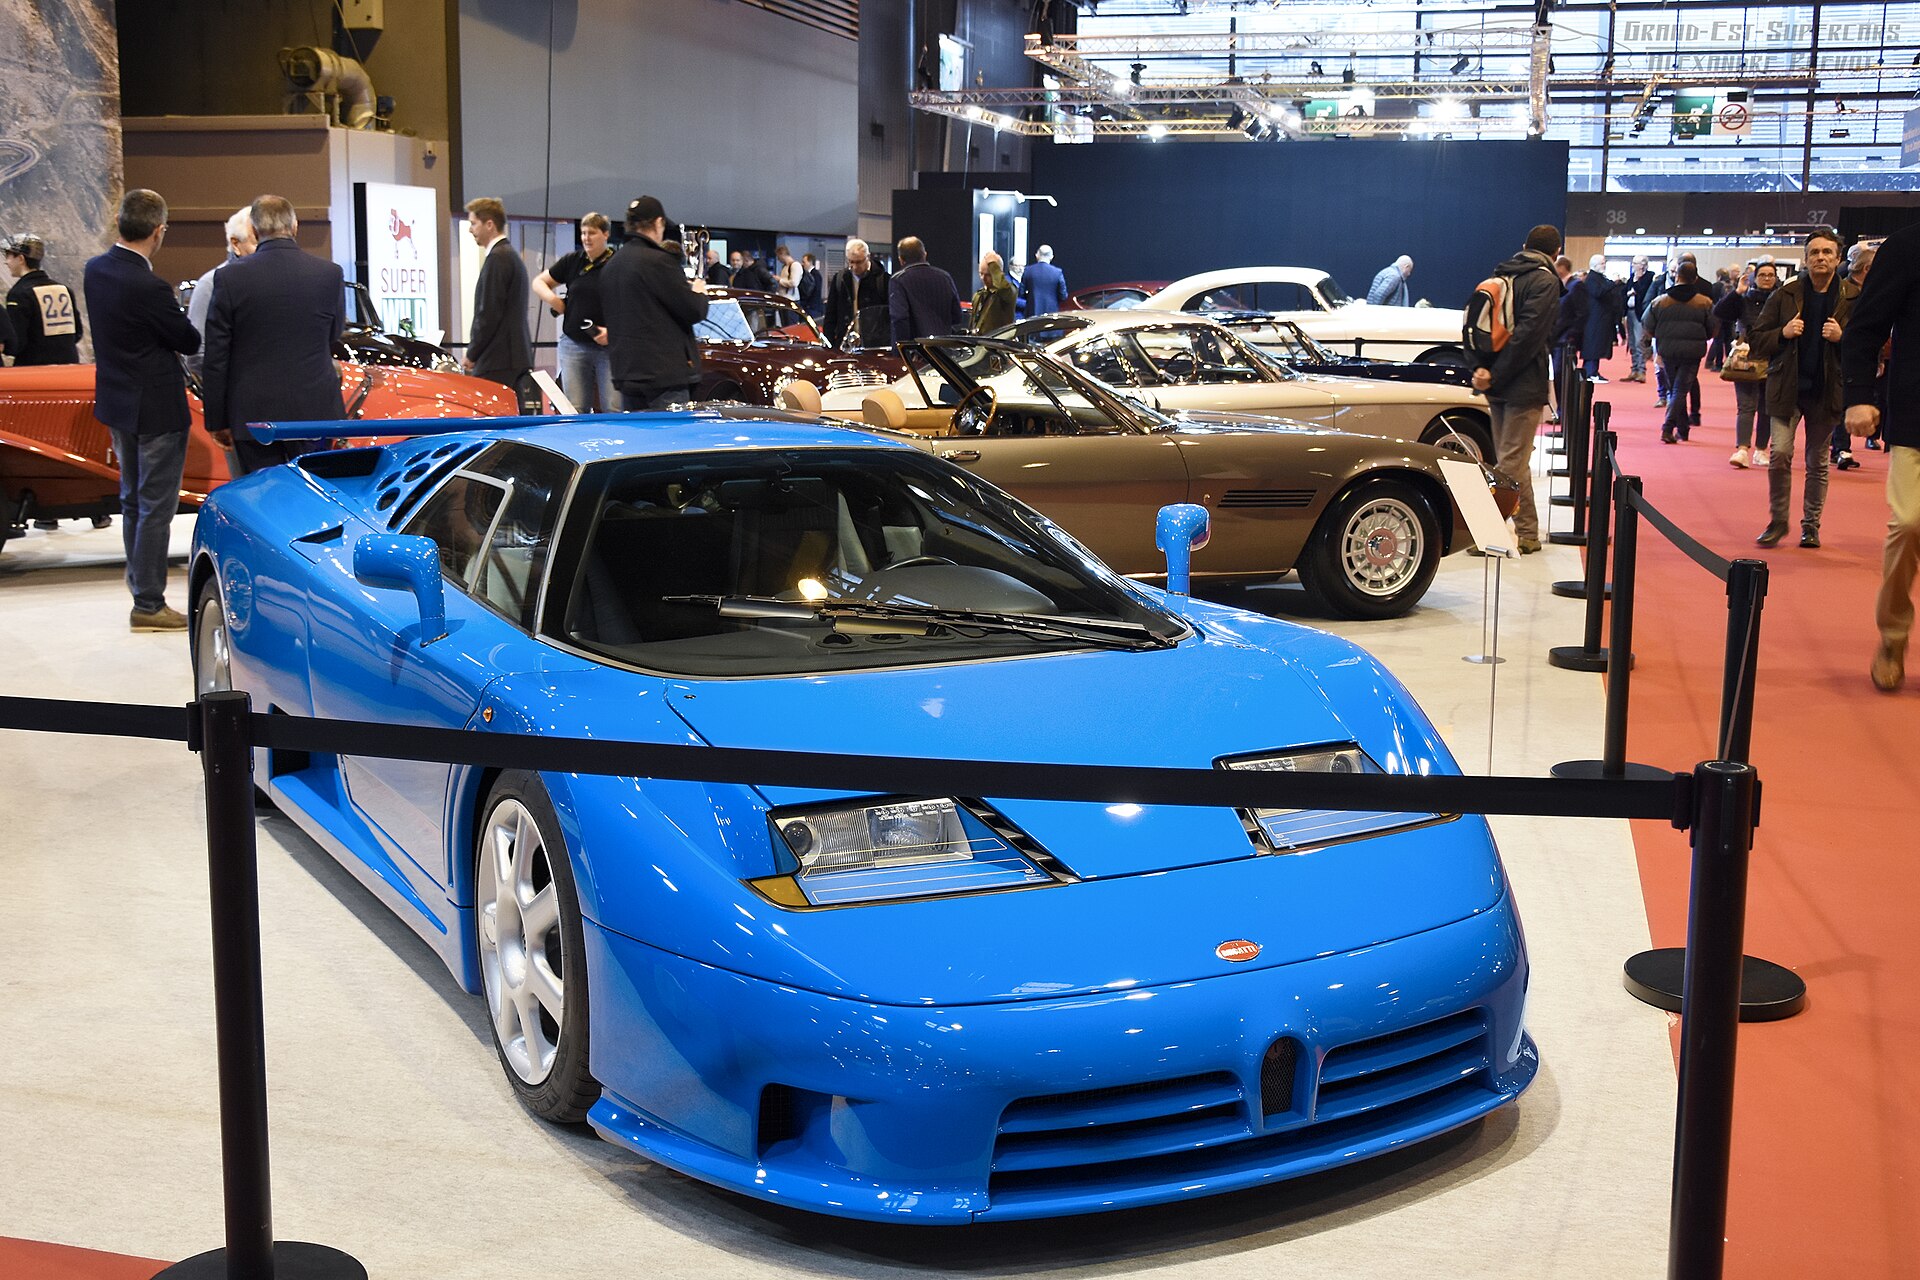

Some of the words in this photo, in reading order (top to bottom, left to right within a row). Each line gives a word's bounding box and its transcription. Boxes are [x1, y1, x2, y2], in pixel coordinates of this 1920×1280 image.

[1605, 210, 1627, 225] 38
[1806, 210, 1828, 225] 37
[381, 267, 427, 293] SUPER
[43, 293, 73, 320] 22
